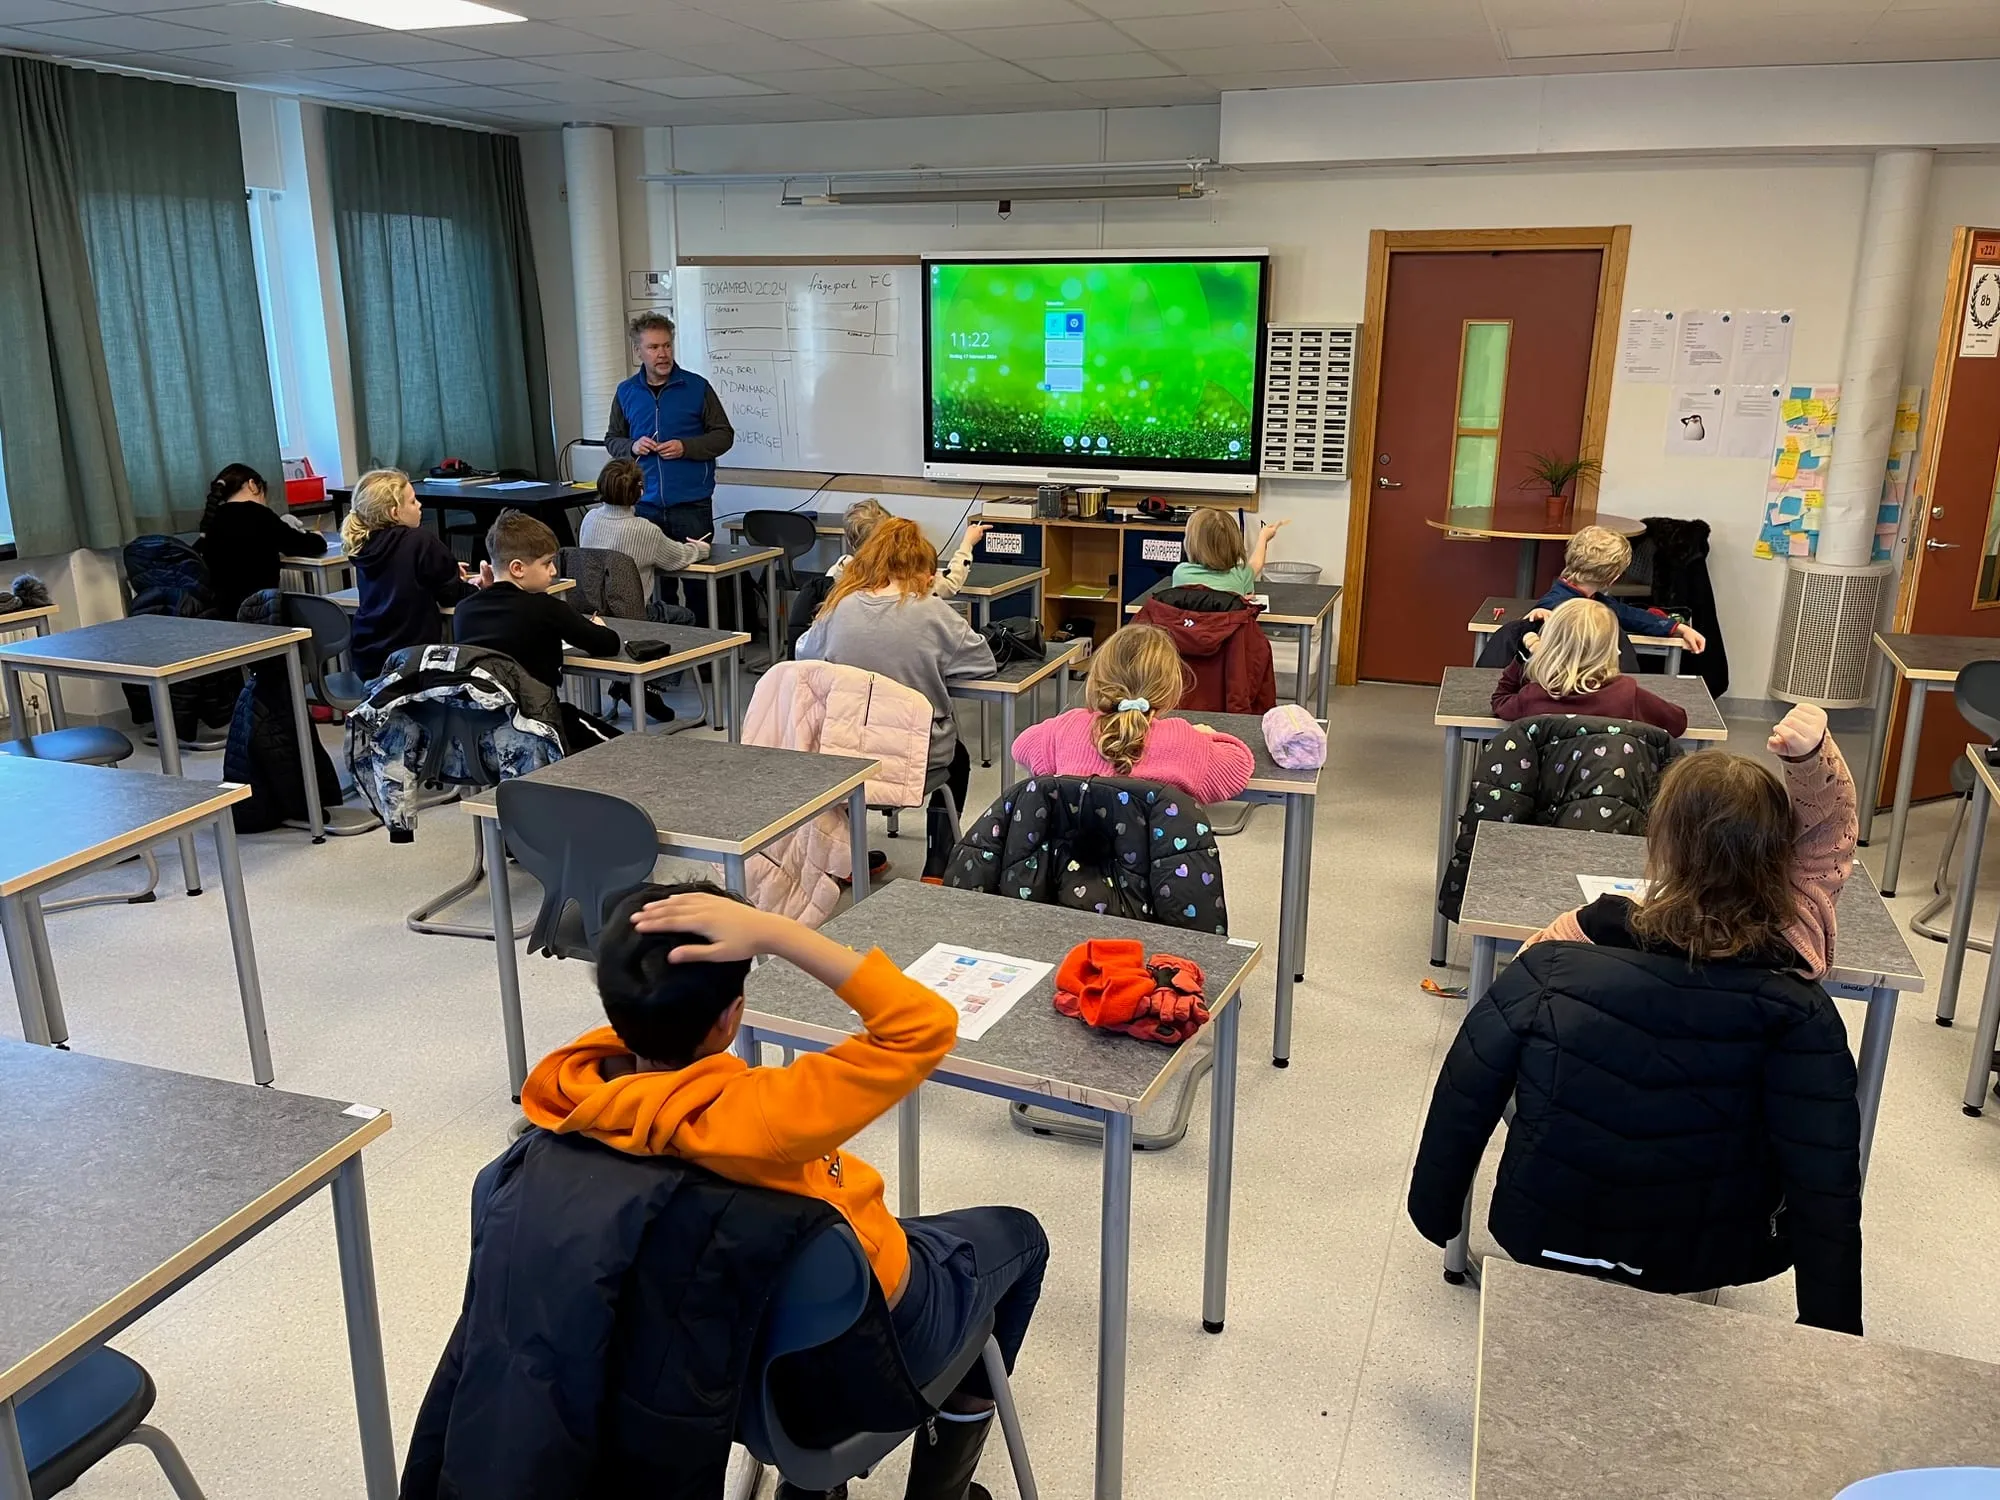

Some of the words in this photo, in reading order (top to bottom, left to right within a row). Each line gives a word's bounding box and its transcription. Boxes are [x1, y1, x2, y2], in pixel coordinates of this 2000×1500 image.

[753, 281, 787, 296] 2024
[1980, 295, 1991, 306] 8b
[950, 332, 990, 347] 11:22
[713, 366, 733, 376] JAG
[729, 381, 777, 398] DANMARK
[732, 401, 771, 418] NORGE
[735, 429, 782, 451] SVERIGE
[987, 536, 1021, 550] RITPAPPER
